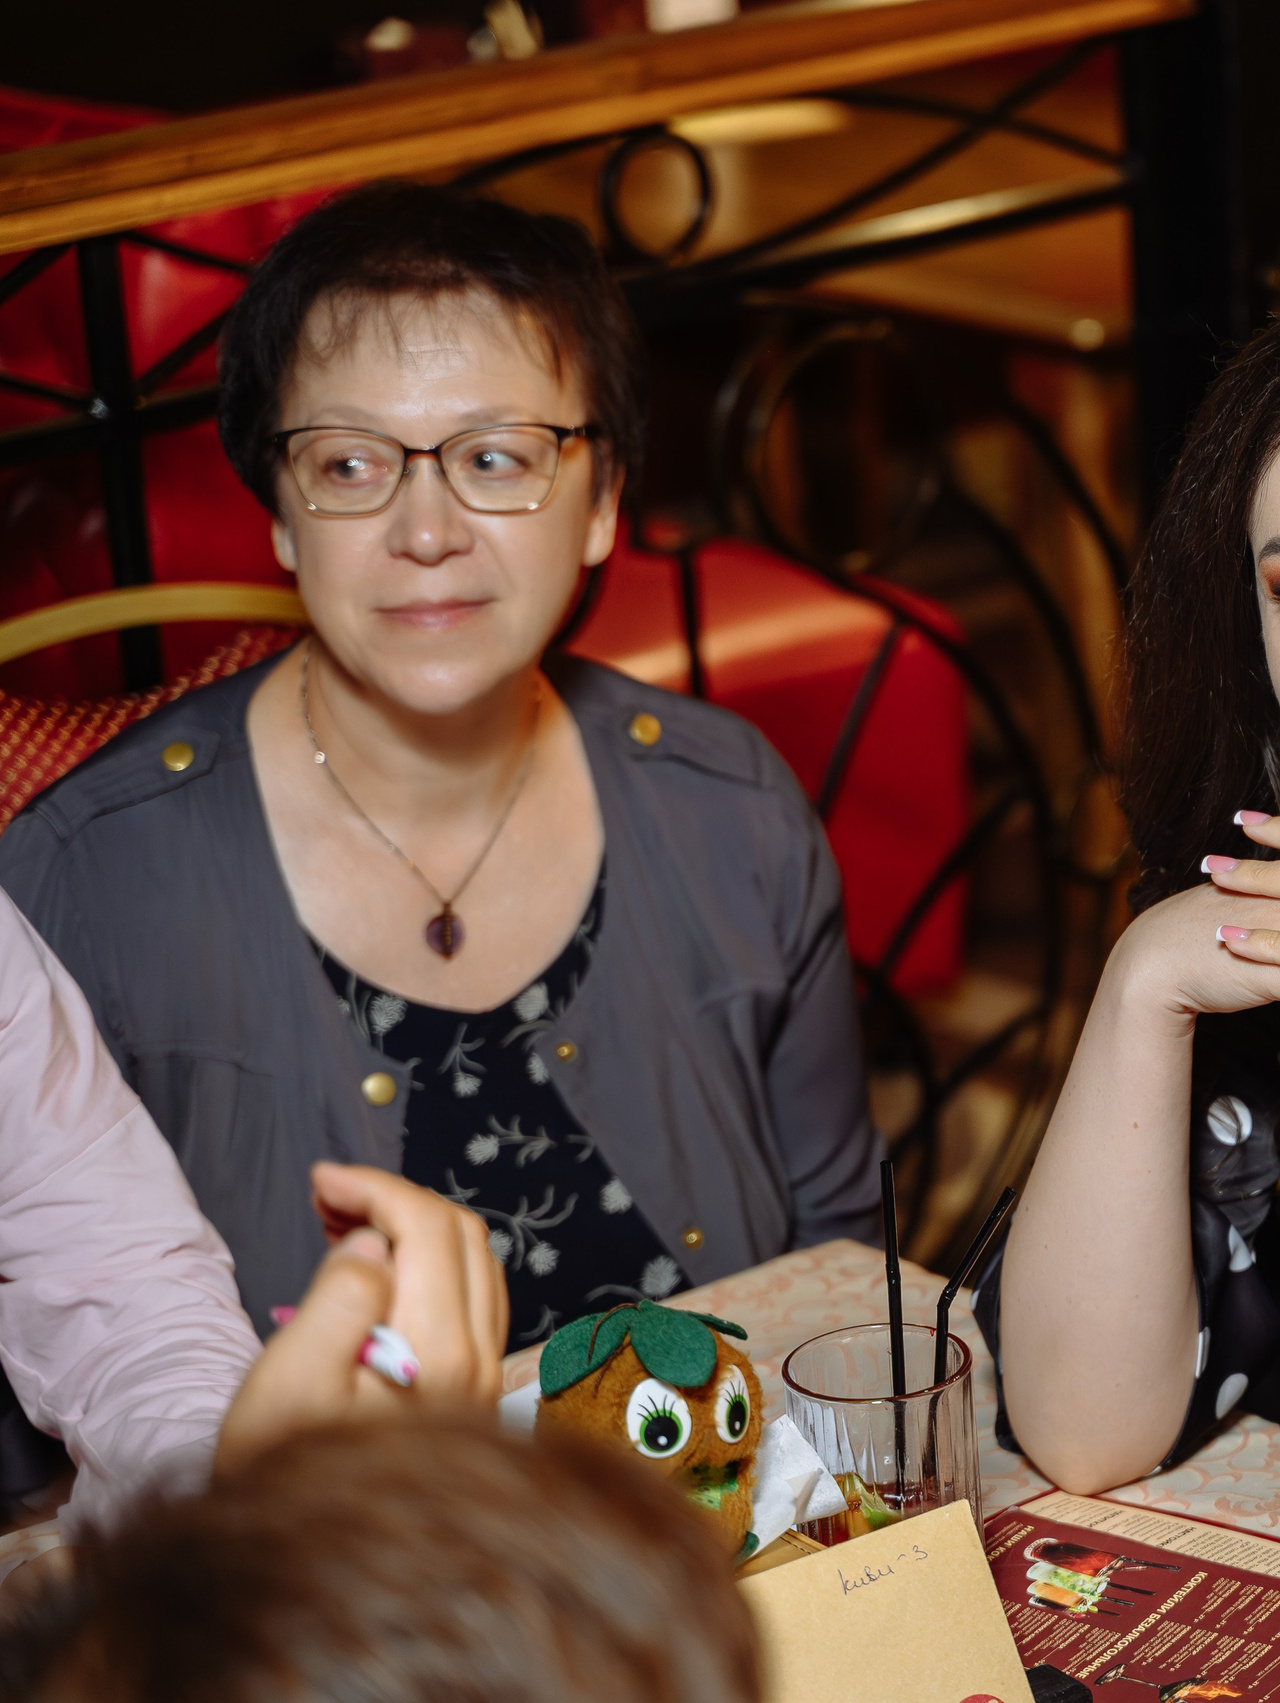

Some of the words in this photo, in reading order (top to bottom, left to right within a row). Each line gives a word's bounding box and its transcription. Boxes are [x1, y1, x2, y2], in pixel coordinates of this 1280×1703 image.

[1004, 1525, 1034, 1547] НАШИ
[1157, 1571, 1208, 1614] КОКТЕЙЛИ
[1075, 1613, 1161, 1679] БЕЗАЛКОГОЛЬНЫЕ
